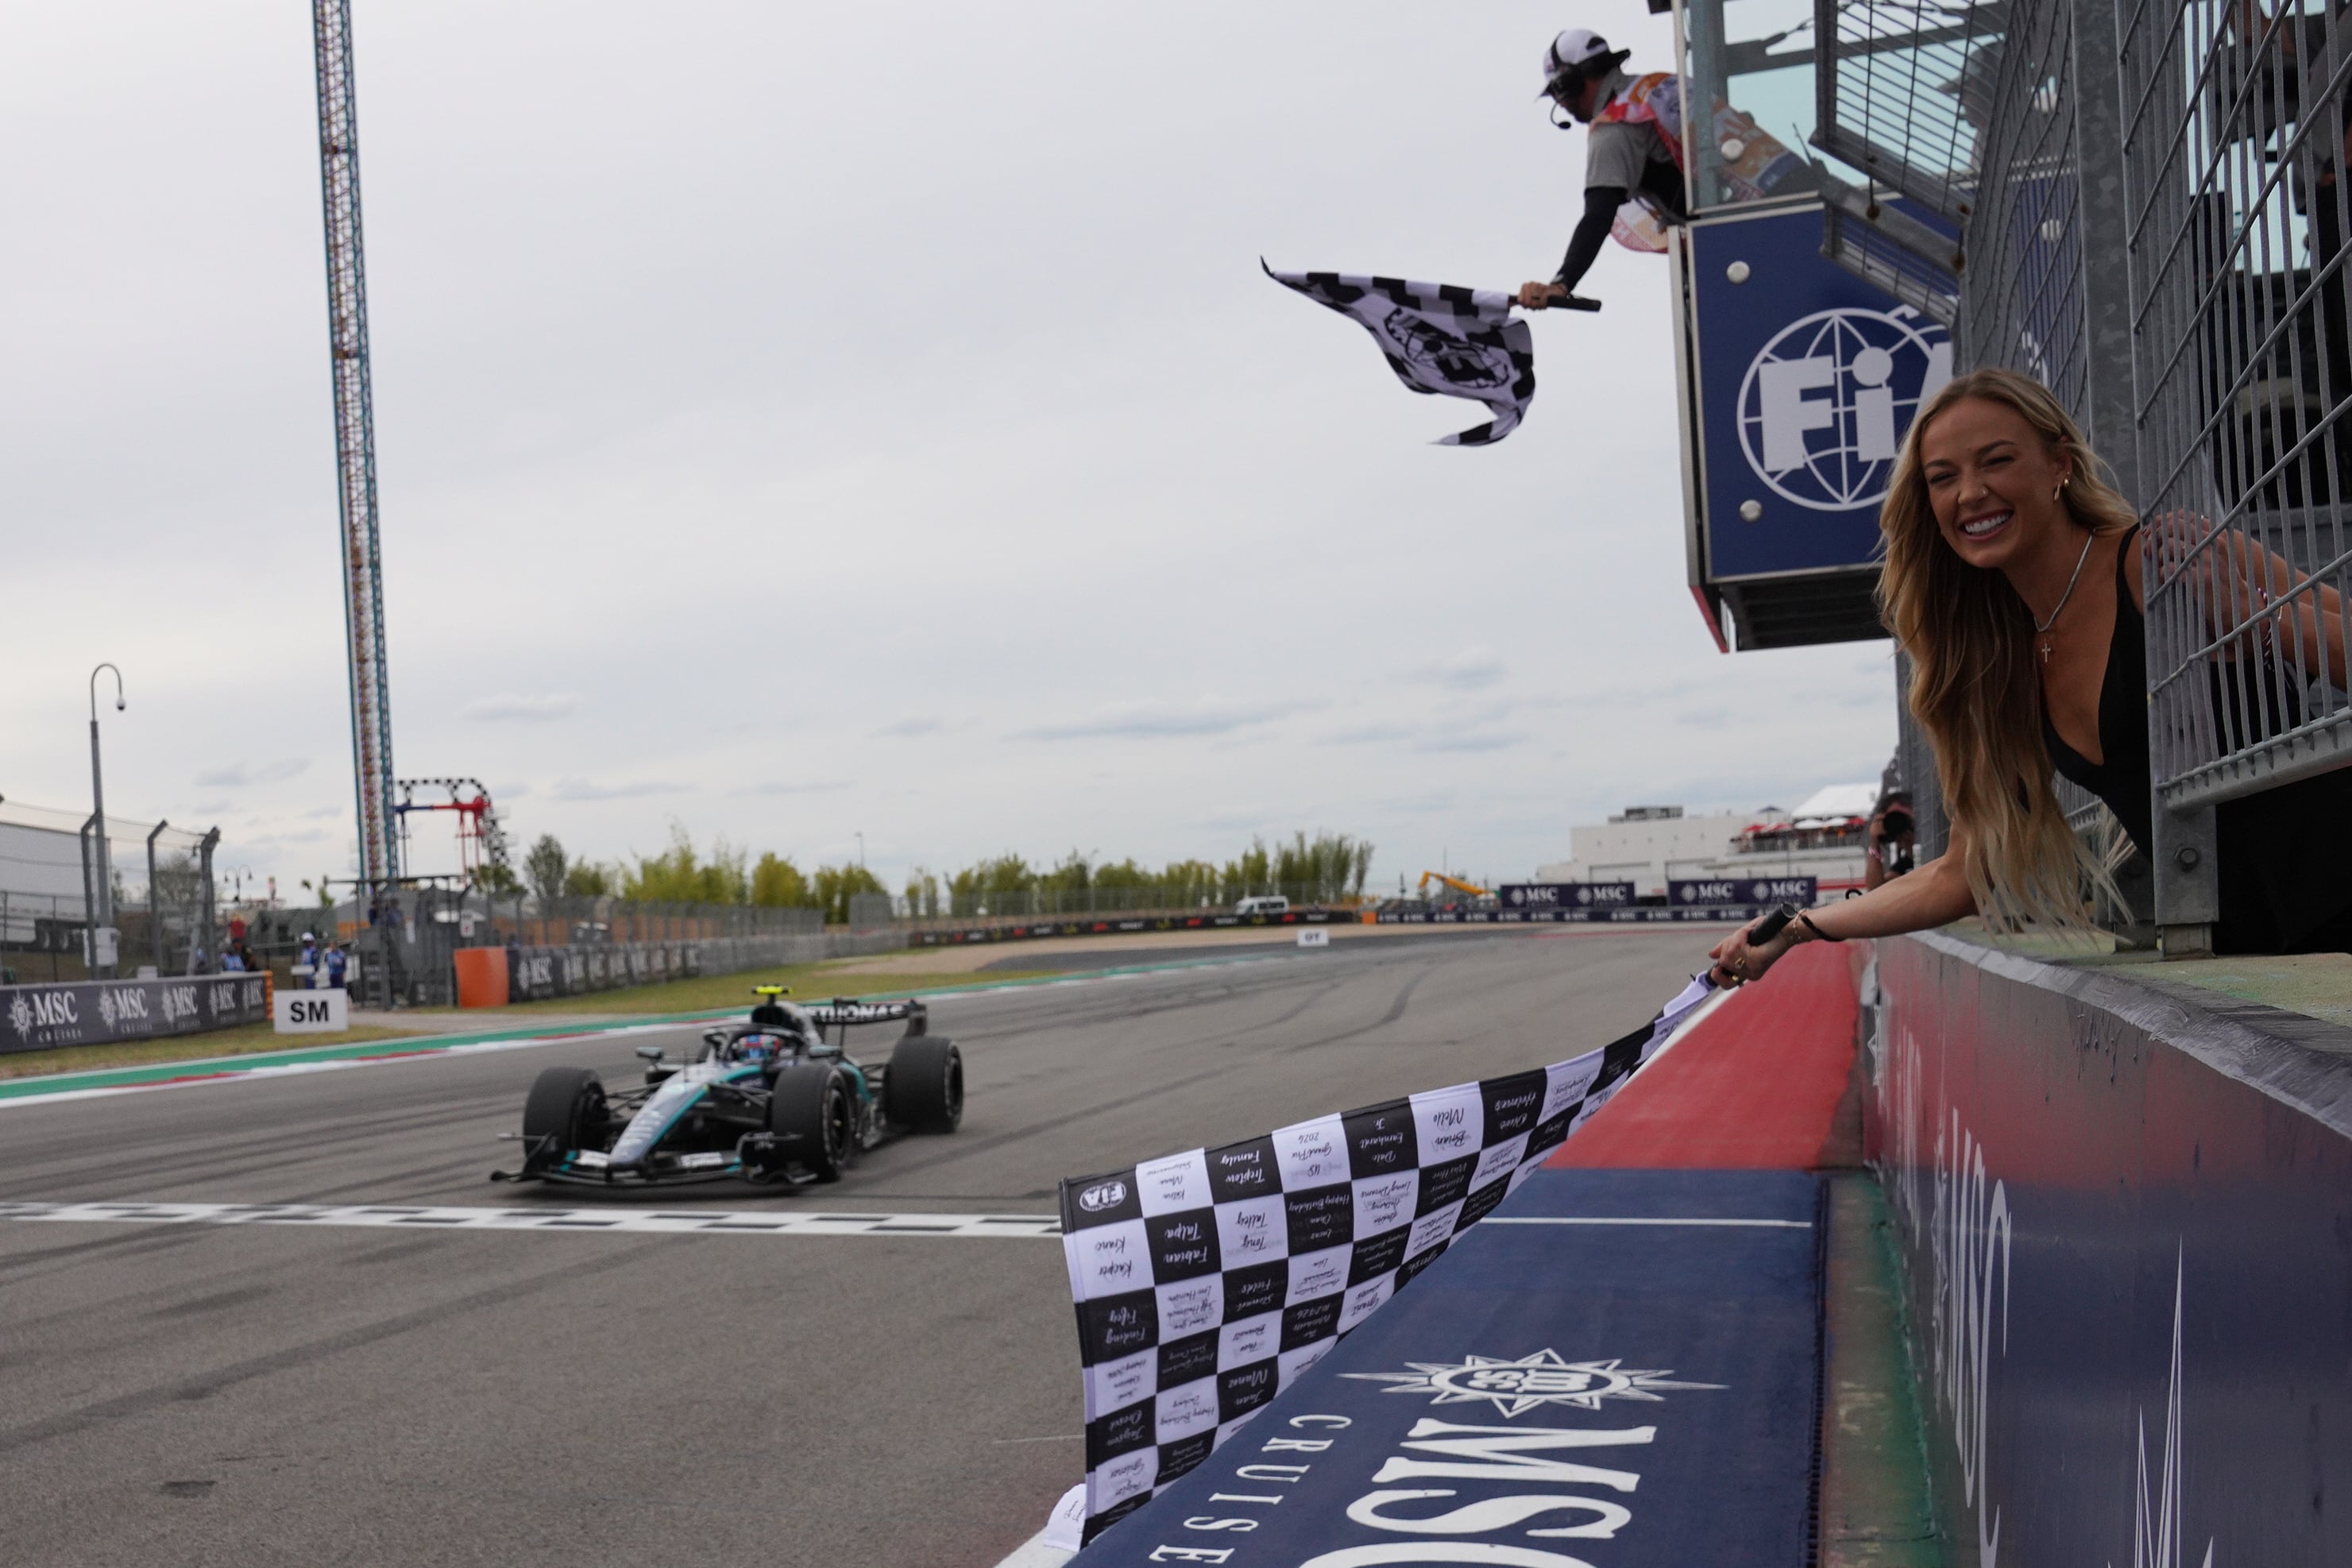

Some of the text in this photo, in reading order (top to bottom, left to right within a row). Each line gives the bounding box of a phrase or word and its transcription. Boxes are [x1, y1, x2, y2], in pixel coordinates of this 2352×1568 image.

[1698, 882, 1735, 899] MSC
[1772, 879, 1808, 896] MSC
[33, 991, 78, 1026] MSC
[114, 987, 149, 1020] MSC
[172, 985, 199, 1017] MSC
[291, 1000, 329, 1023] SM
[1373, 1118, 1385, 1130] Jr.
[1433, 1107, 1464, 1126] Mello
[1360, 1132, 1403, 1149] Earnhardt
[1435, 1130, 1466, 1147] Brian
[1220, 1150, 1260, 1166] Family
[1308, 1142, 1331, 1157] Grand
[1373, 1150, 1396, 1163] Dale
[1225, 1168, 1265, 1184] Treptow
[1082, 1184, 1124, 1207] FIA
[1288, 1195, 1350, 1213] Happy Birthday
[1164, 1222, 1201, 1242] Talpa
[1164, 1246, 1207, 1265] Fabian
[1241, 1278, 1271, 1294] Fields
